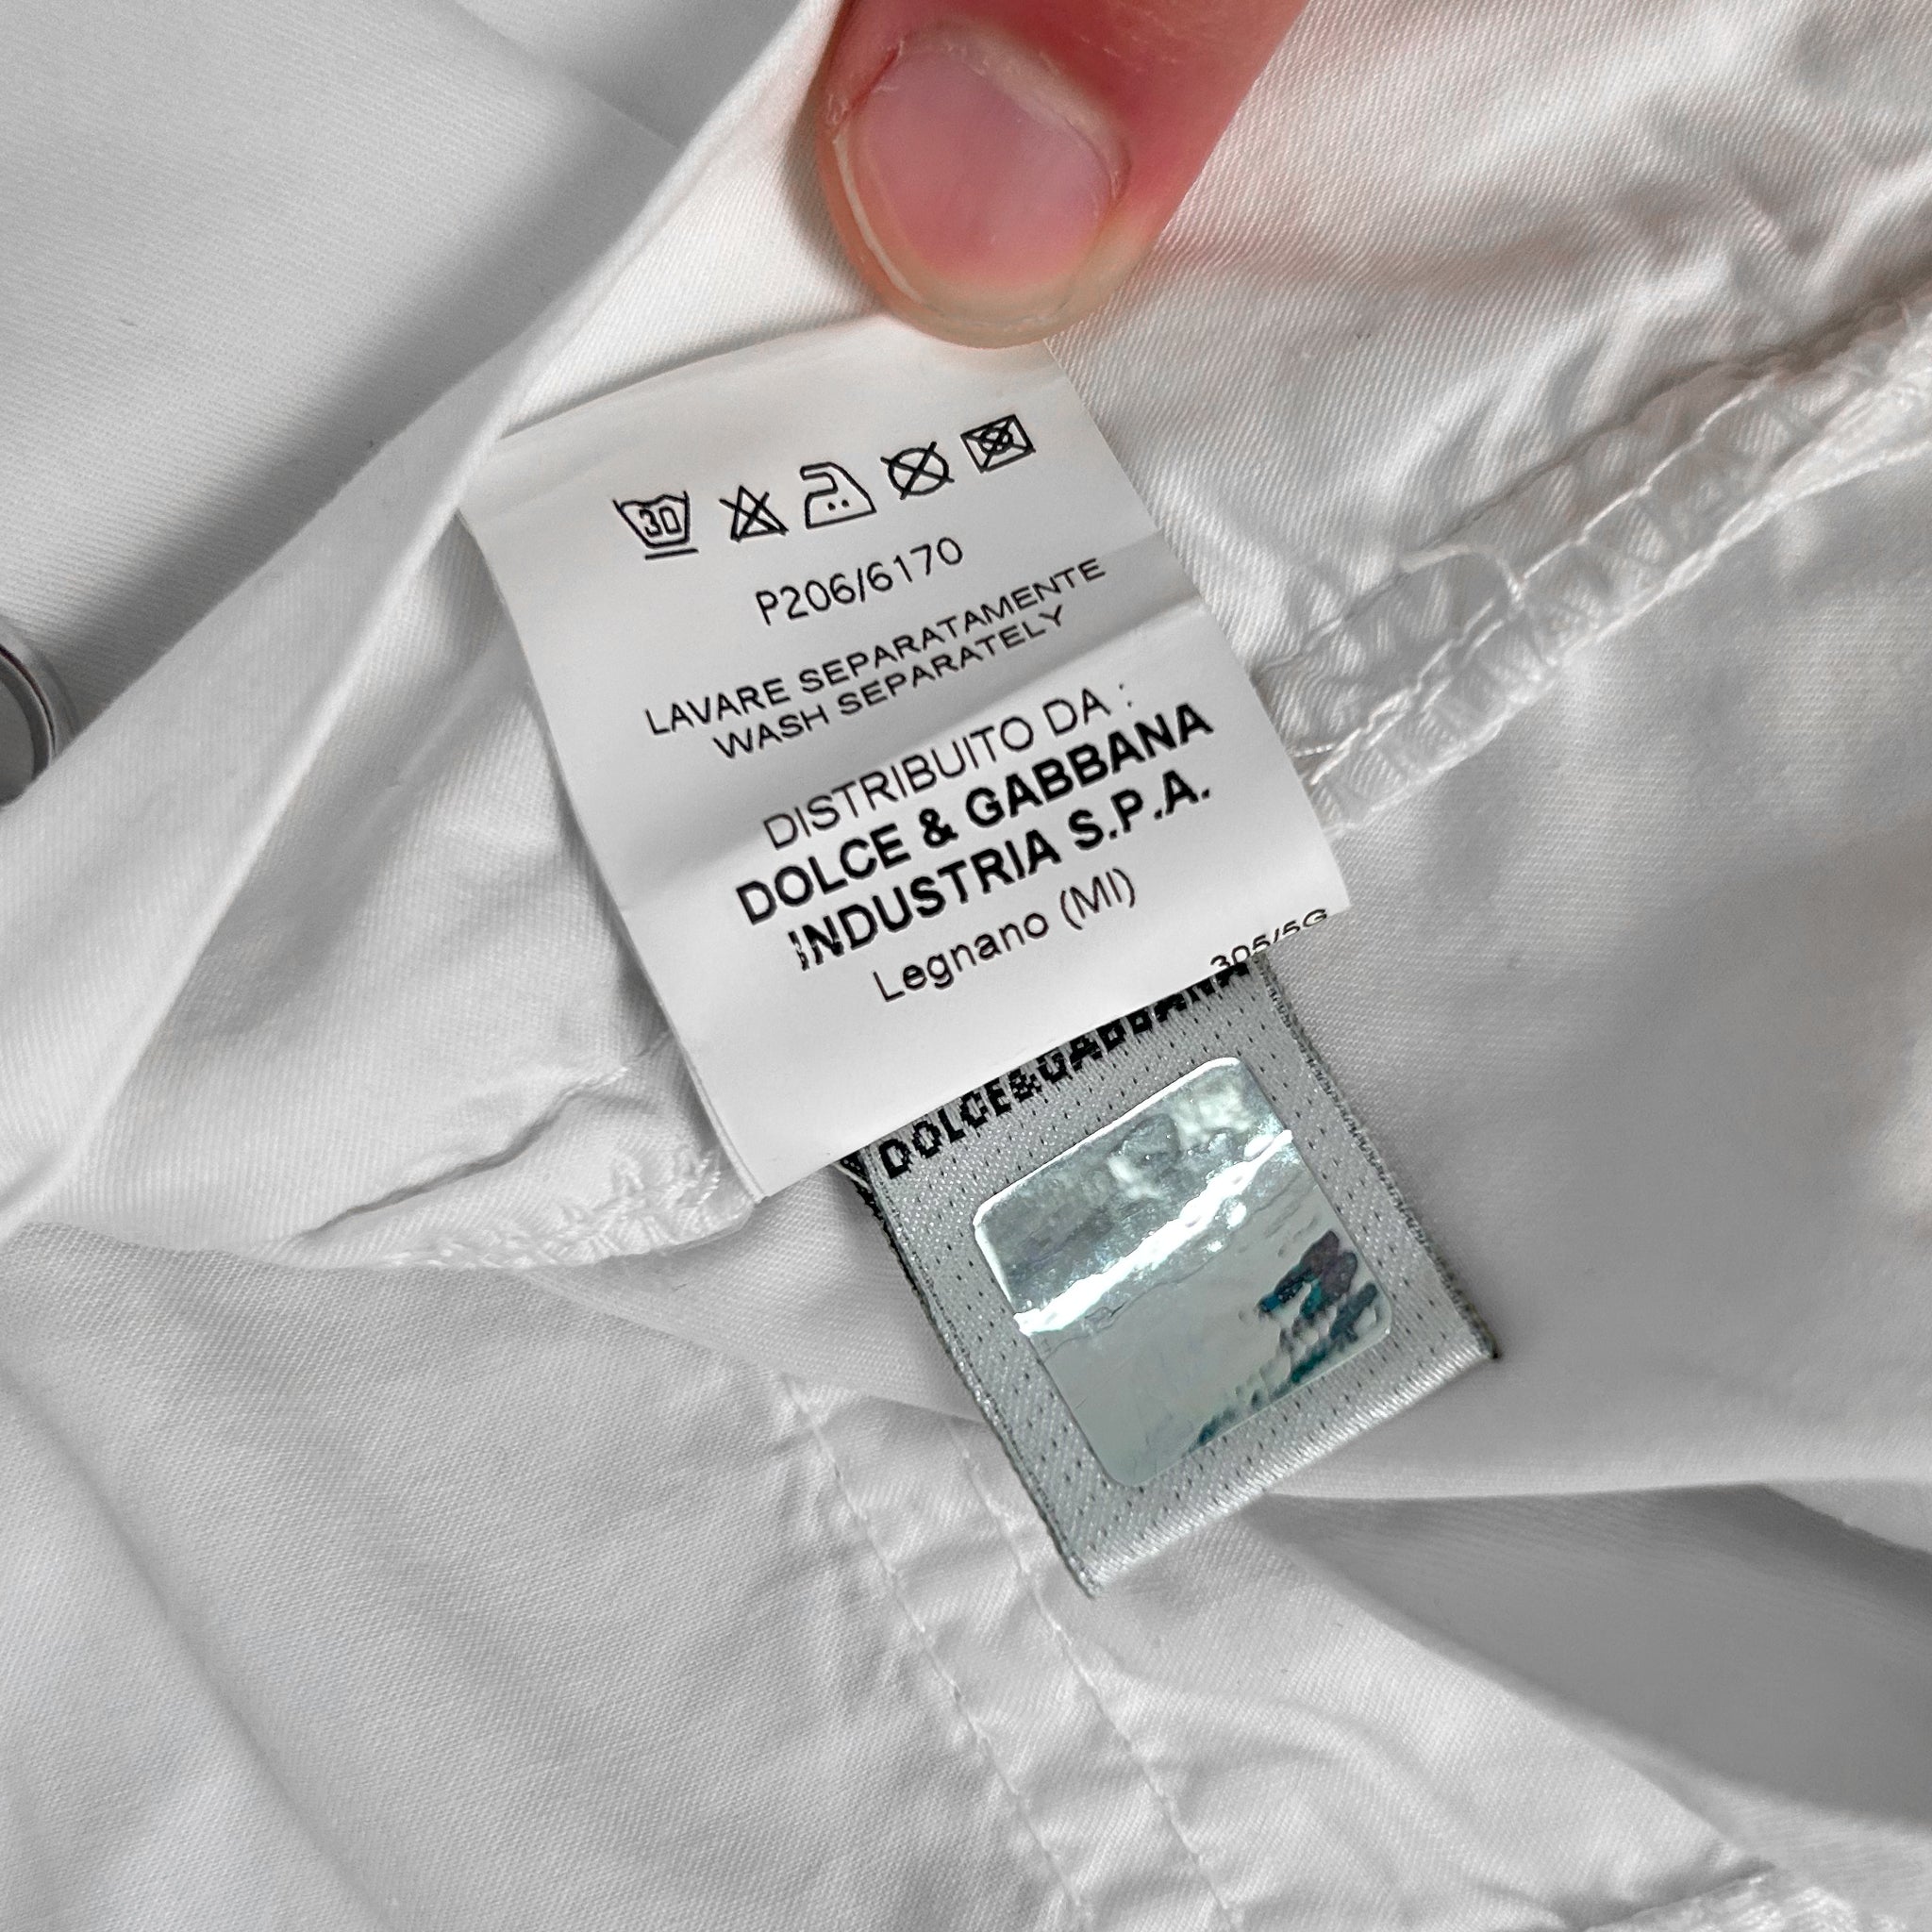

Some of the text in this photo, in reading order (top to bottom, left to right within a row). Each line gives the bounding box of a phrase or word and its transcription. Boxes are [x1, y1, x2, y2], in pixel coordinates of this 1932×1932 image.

[640, 506, 682, 538] 30
[755, 537, 963, 625] P206/6170
[645, 558, 1107, 736] LAVARE SEPARATAMENTE
[712, 605, 1064, 759] WASH SEPARATELY
[736, 703, 1214, 924] DOLCE & GABBANA
[763, 715, 1035, 850] DISTRIBUITO
[787, 768, 1211, 971] INDUSTRIA S.P.A.
[873, 867, 1137, 1003] Legnano (MI)
